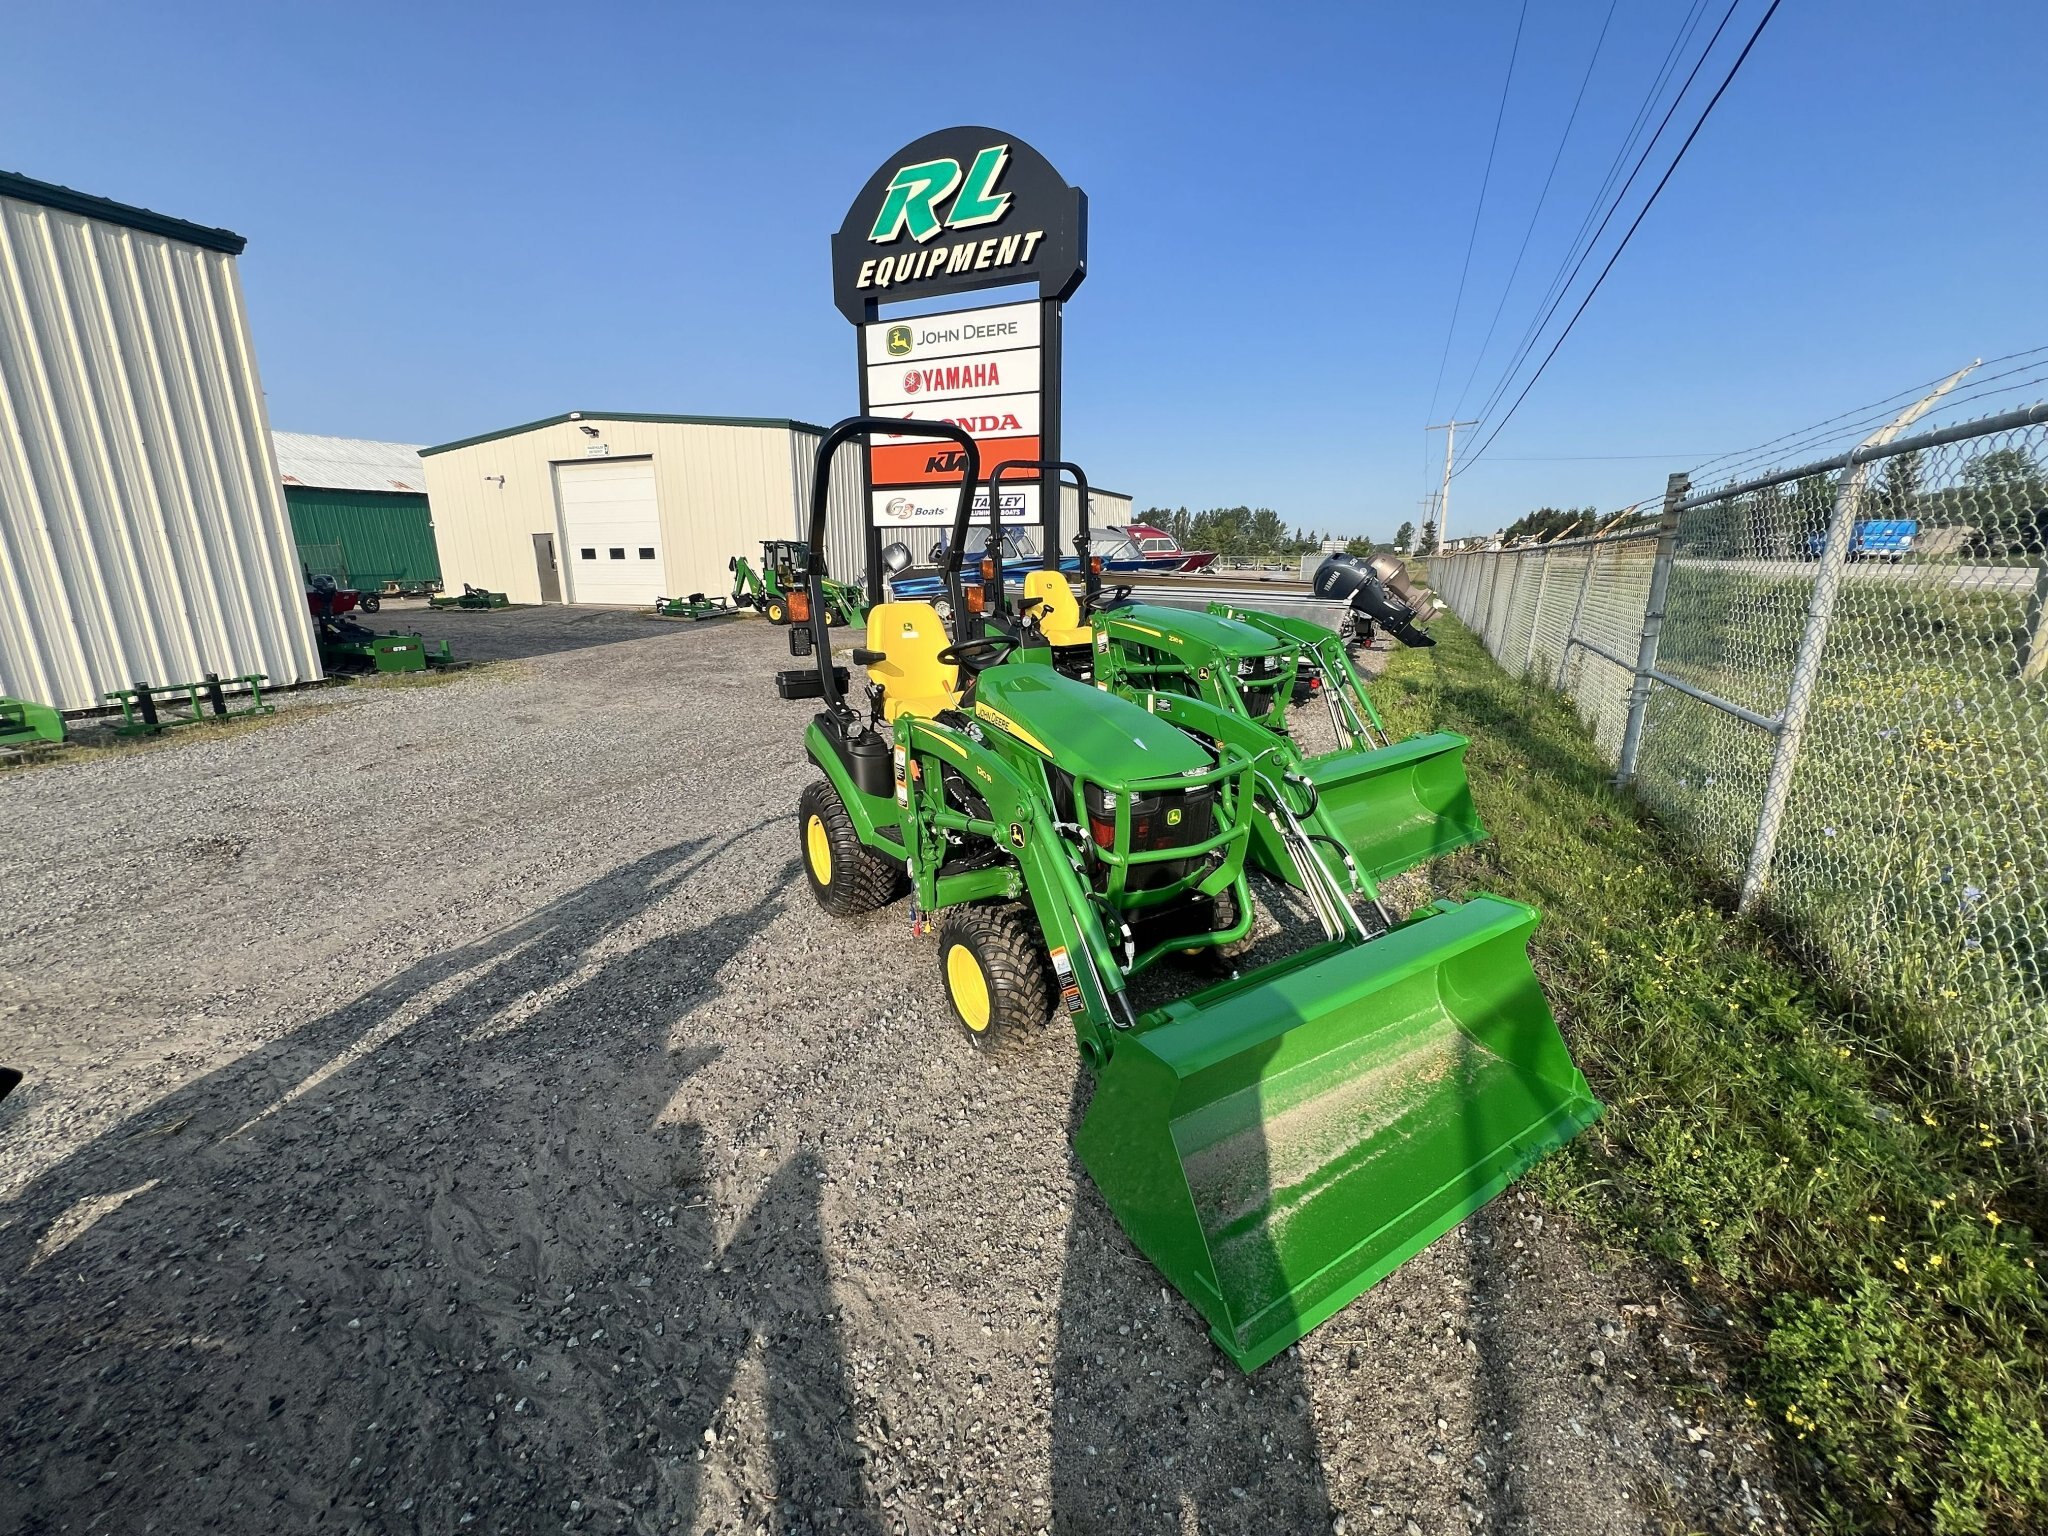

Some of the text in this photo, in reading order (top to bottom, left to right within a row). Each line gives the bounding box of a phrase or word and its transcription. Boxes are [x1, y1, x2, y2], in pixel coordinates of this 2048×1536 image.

[867, 143, 1013, 243] RL
[855, 230, 1045, 289] EQUIPMENT
[916, 321, 1018, 346] JOHN DEERE
[922, 362, 1000, 392] YAMAHA
[941, 414, 1023, 433] NDA
[885, 497, 945, 520] G3 Boats
[973, 495, 1023, 508] TALEY
[1000, 509, 1021, 517] BOATS
[1323, 570, 1340, 591] YAMAHA
[991, 712, 1010, 731] DEERE
